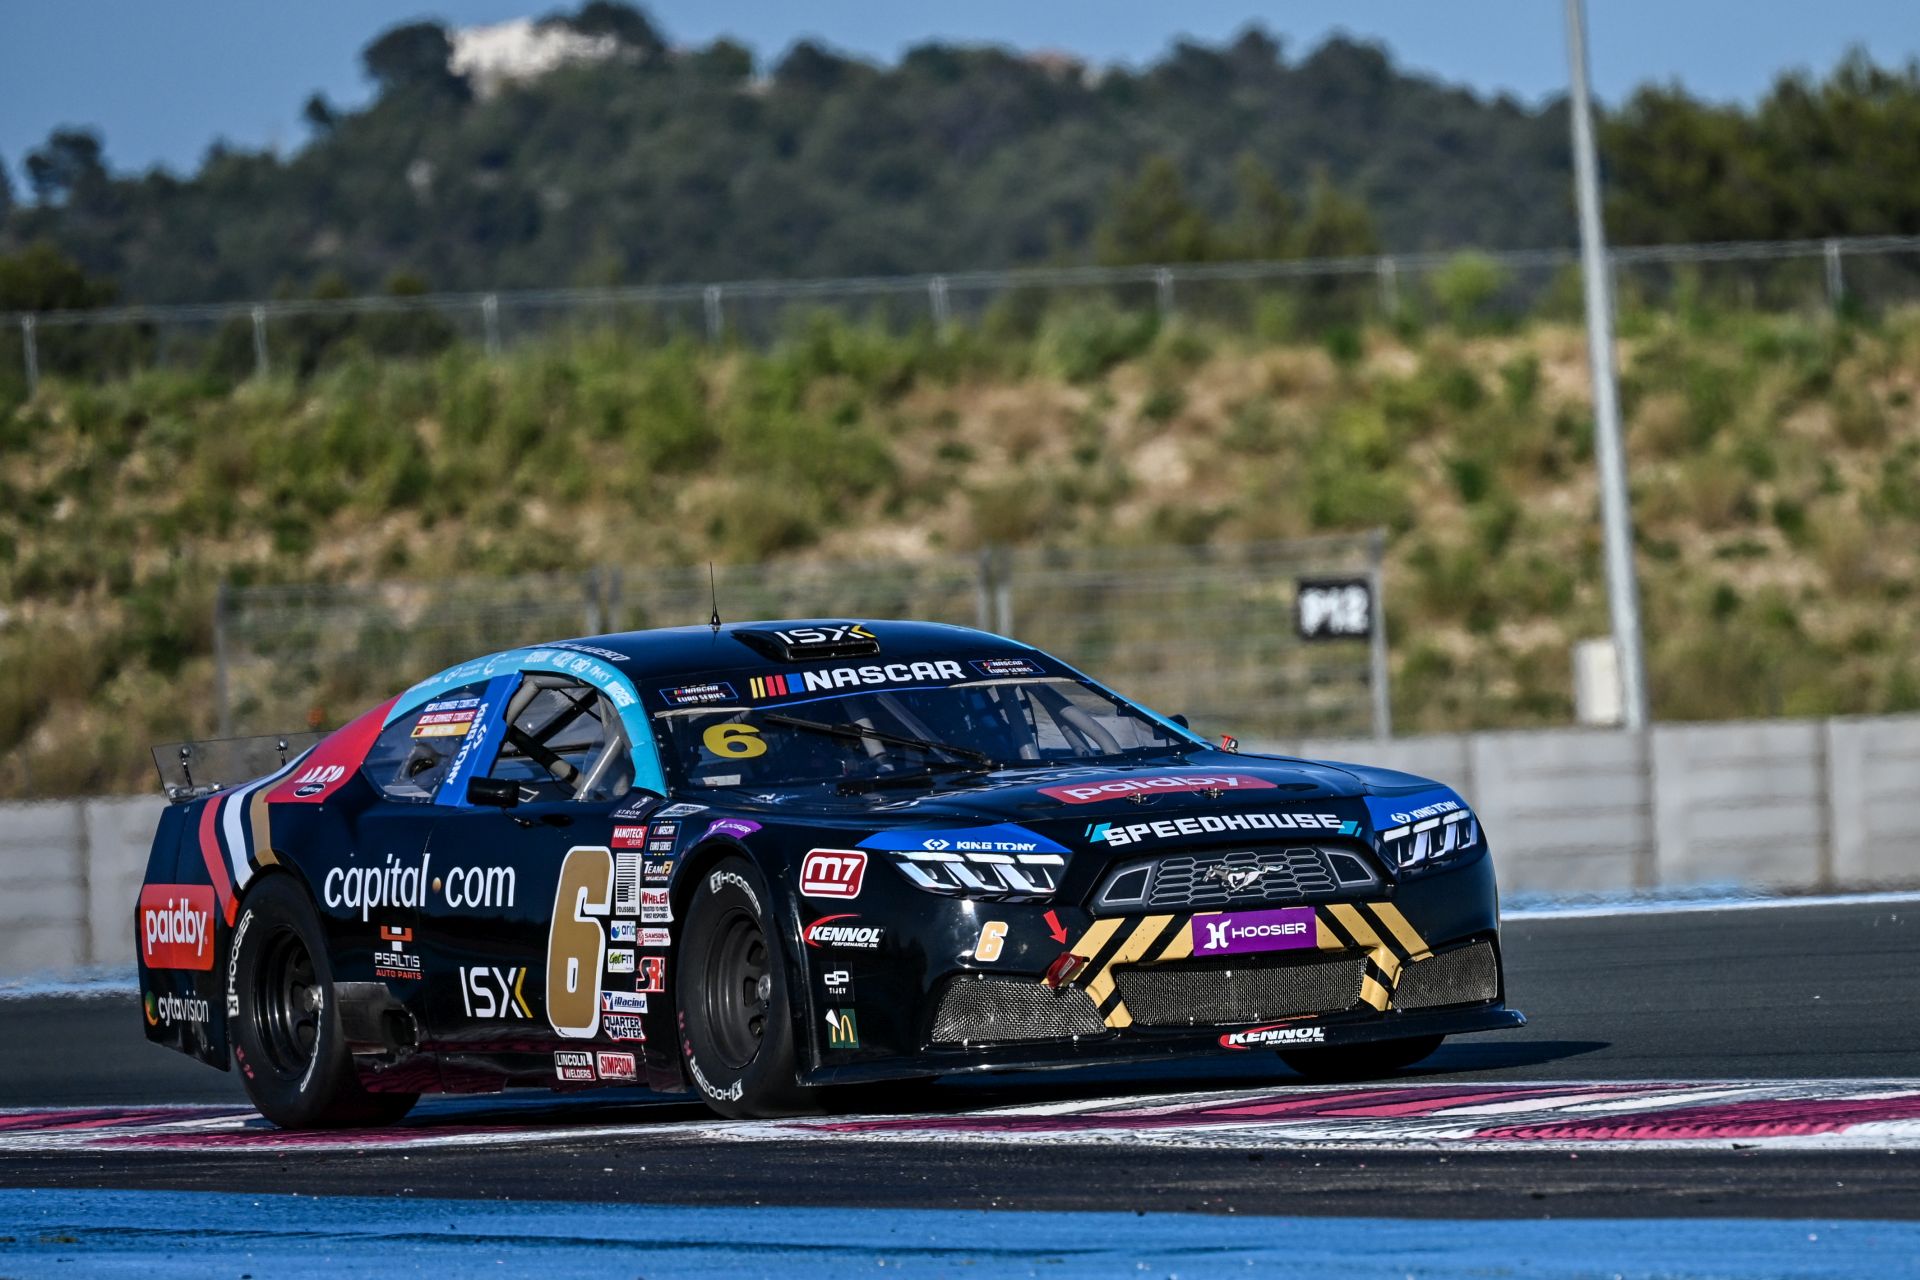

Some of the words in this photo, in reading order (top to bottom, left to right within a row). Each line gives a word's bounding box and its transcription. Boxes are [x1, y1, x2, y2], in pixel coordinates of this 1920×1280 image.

[803, 660, 967, 692] NASCAR
[684, 685, 719, 694] NASCAR
[702, 723, 768, 759] 6
[1062, 774, 1239, 801] paidby
[1101, 813, 1347, 847] SPEEDHOUSE
[956, 841, 992, 850] KING
[996, 842, 1037, 851] TONY
[145, 898, 207, 957] paidby
[808, 926, 880, 943] KENNOL
[1232, 922, 1307, 939] HOOSIER
[546, 846, 615, 1038] 6
[974, 921, 1009, 962] 6
[227, 908, 255, 994] HOOSIER
[374, 951, 421, 968] PSALTIS
[375, 969, 396, 978] AUTO
[397, 971, 422, 980] PARTS
[614, 996, 646, 1009] iRacing
[603, 1015, 641, 1032] QUARTER
[1228, 1027, 1325, 1045] KENNOL
[1265, 1037, 1313, 1045] PERFORMANCE
[556, 1053, 587, 1067] LINCOLN
[600, 1056, 633, 1076] SIMPSON
[564, 1068, 592, 1080] WELDERS
